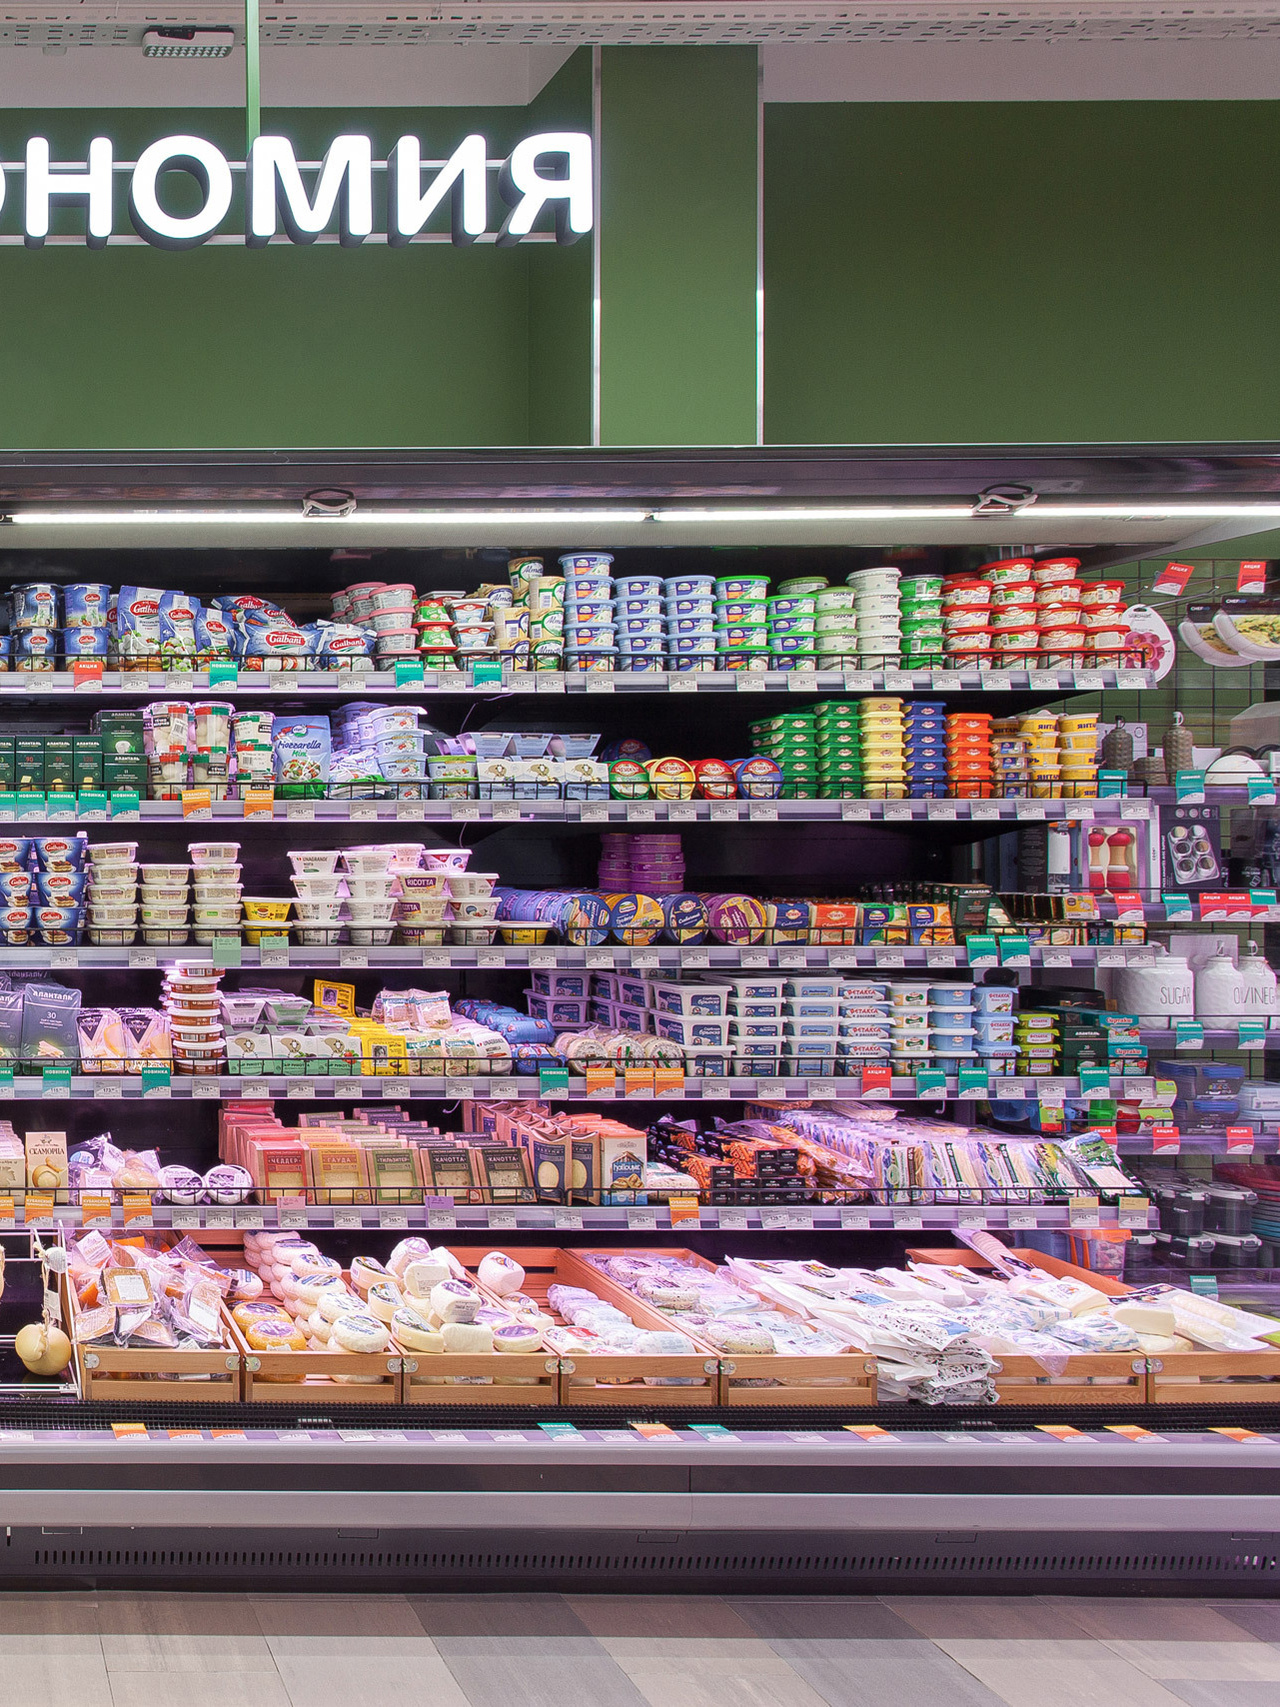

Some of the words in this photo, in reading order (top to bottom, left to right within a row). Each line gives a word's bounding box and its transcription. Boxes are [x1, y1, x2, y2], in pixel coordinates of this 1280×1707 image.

[269, 633, 303, 645] Galbani
[407, 878, 434, 887] RICOTTA
[1160, 986, 1190, 1005] SUGAR
[47, 1012, 56, 1020] 30
